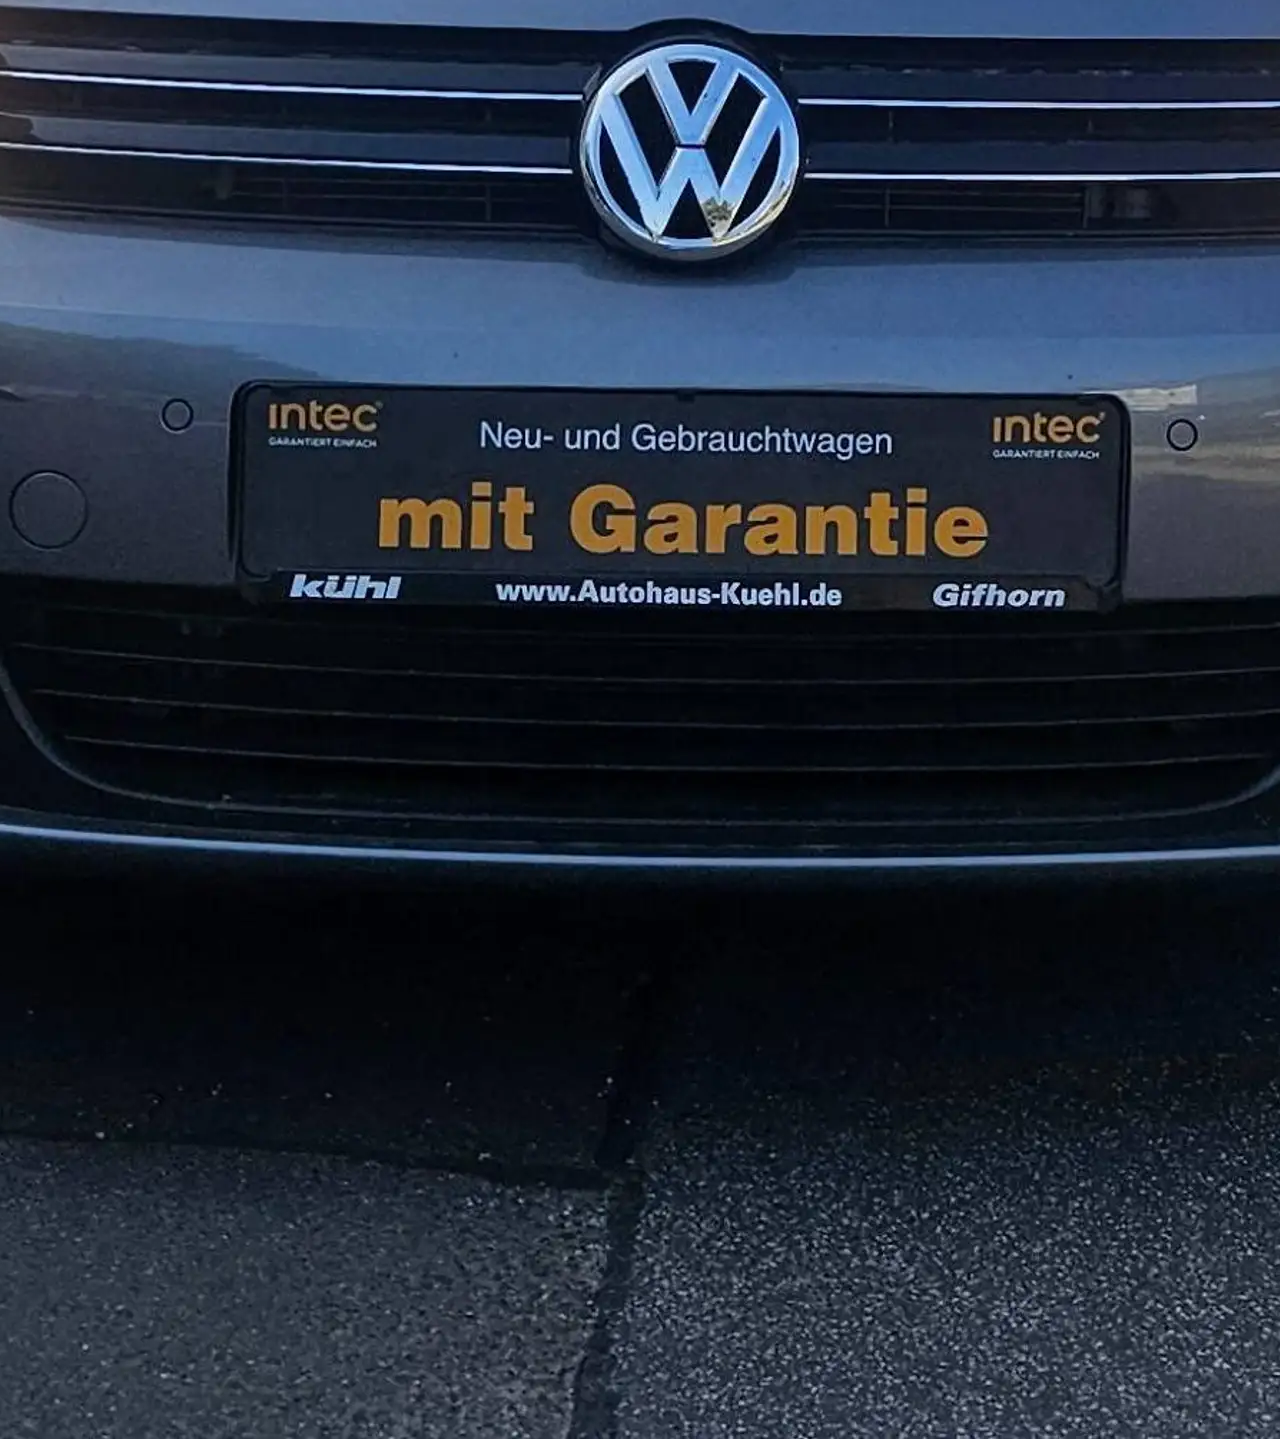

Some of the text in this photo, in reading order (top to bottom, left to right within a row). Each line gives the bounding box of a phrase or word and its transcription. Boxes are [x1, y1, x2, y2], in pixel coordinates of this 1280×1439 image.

[268, 399, 379, 432] intec
[992, 412, 1102, 443] intec
[480, 421, 893, 461] Neu- und Gebrauchtwagen
[379, 481, 989, 557] mit Garantie
[288, 573, 402, 599] kühl
[495, 579, 842, 607] www.Autohaus-Kuehl.de
[932, 582, 1066, 608] Gifhorn
